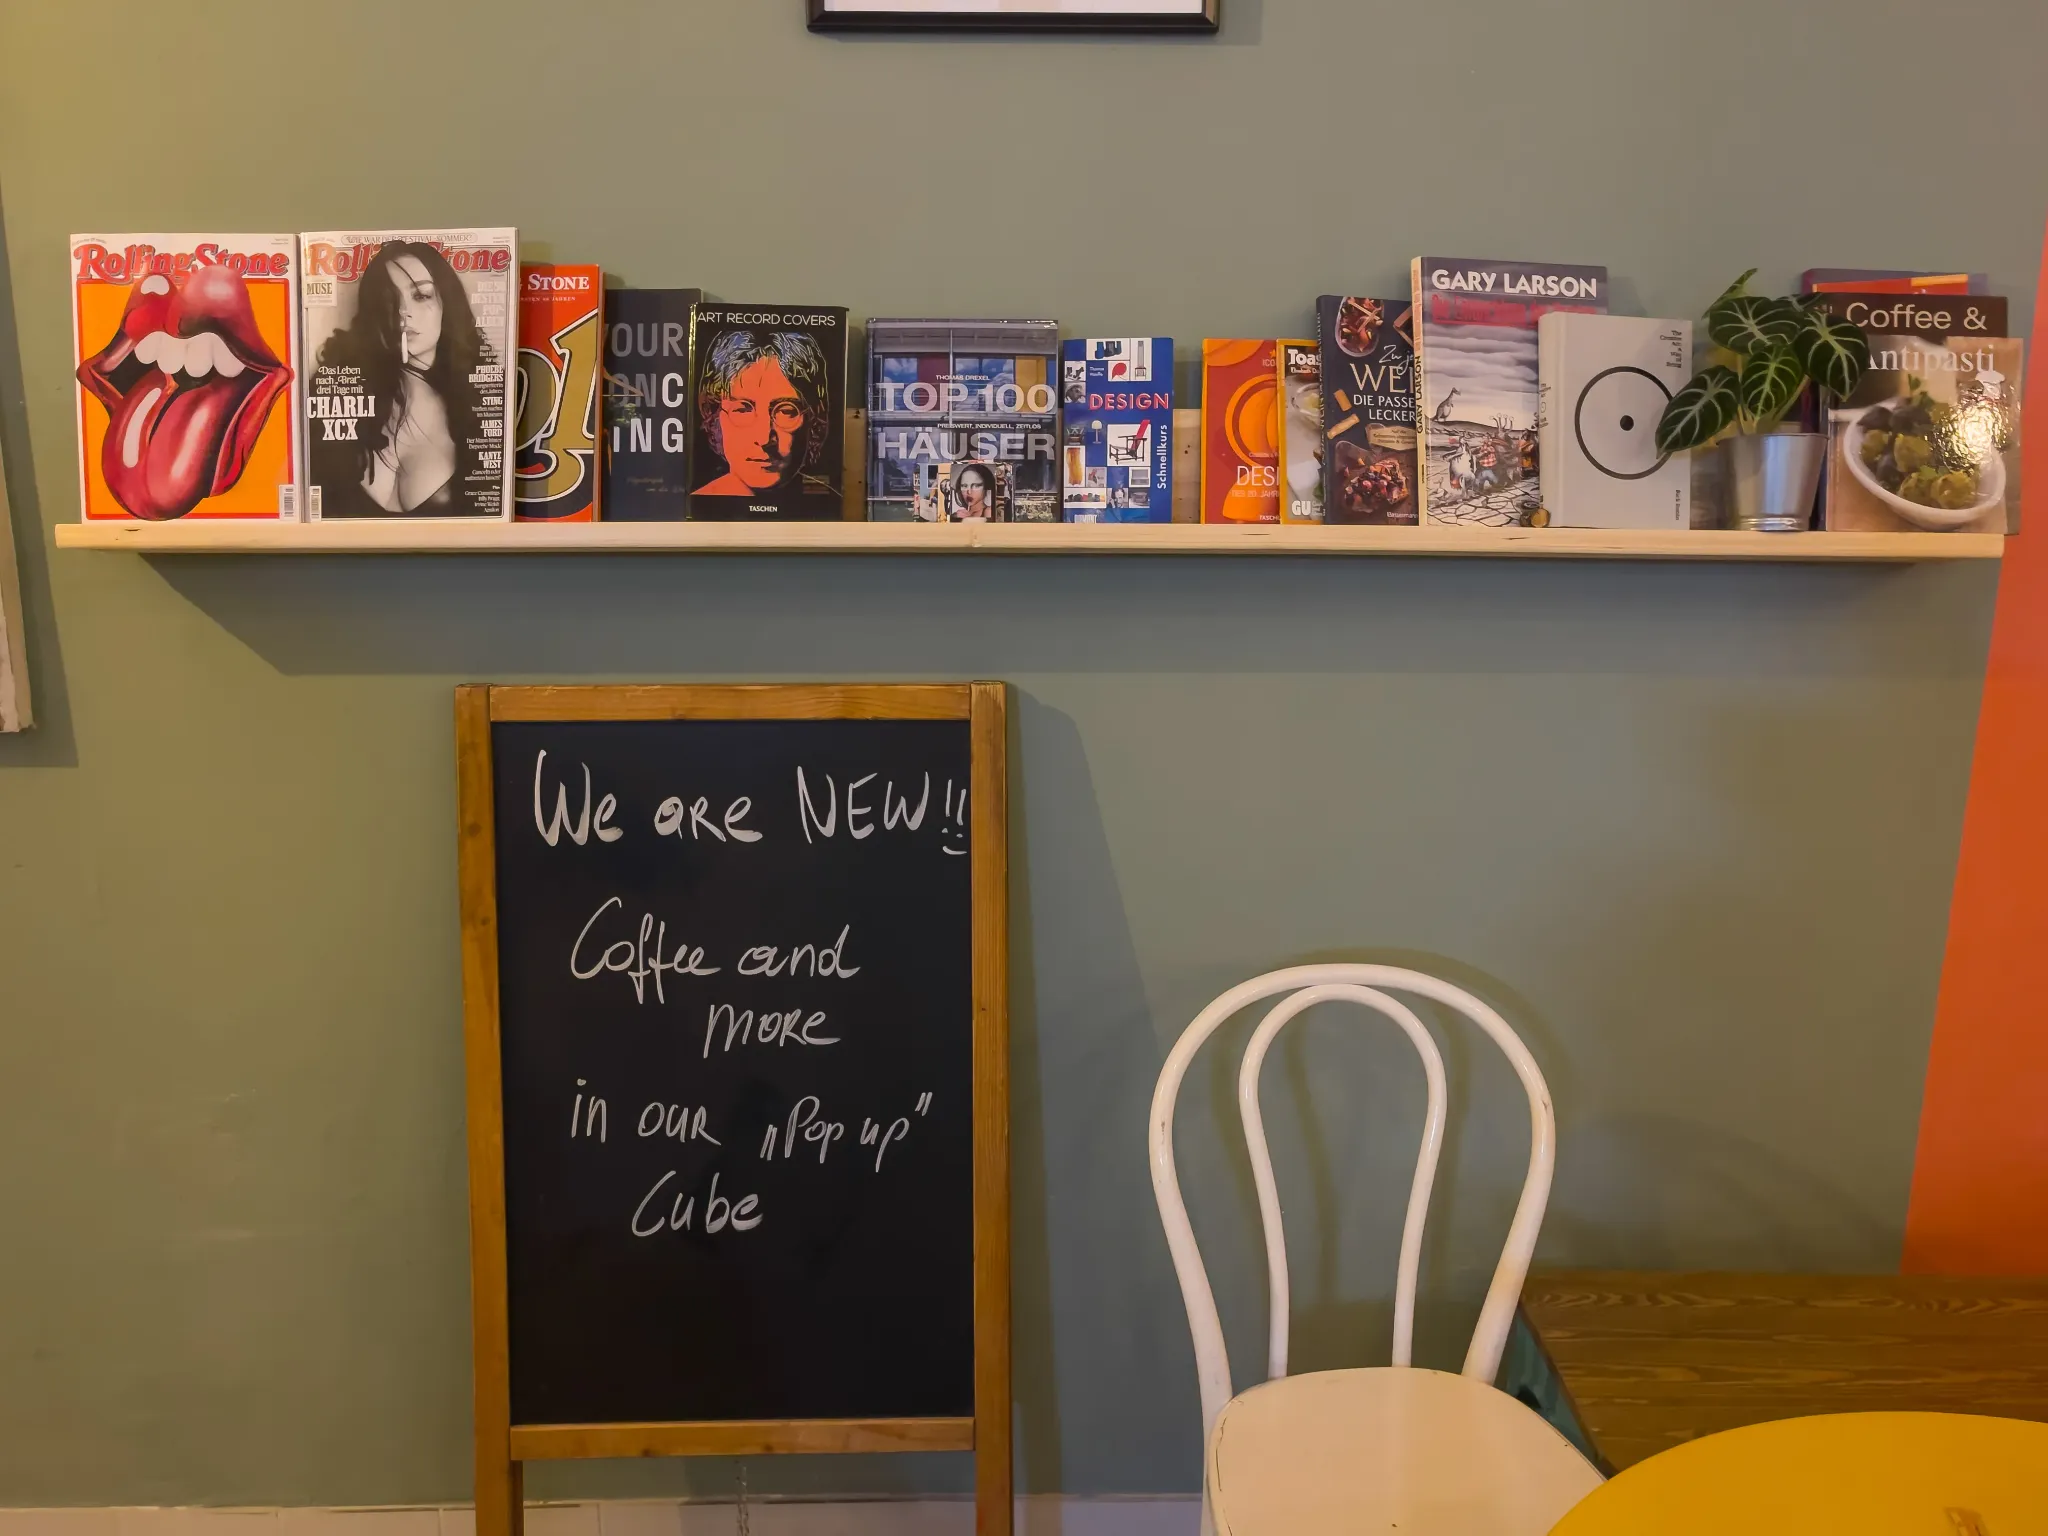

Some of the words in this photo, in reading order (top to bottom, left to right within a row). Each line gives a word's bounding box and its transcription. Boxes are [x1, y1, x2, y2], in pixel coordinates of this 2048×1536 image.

[306, 282, 333, 296] MUSE
[527, 273, 590, 291] STONE
[1431, 269, 1497, 293] GARY
[1503, 272, 1597, 298] LARSON
[697, 312, 723, 323] ART
[726, 313, 780, 325] RECORD
[783, 314, 836, 326] COVERS
[1846, 301, 1951, 330] Coffee
[1963, 306, 1988, 331] &
[318, 366, 336, 375] Das
[337, 365, 361, 375] Leben
[316, 376, 334, 385] nach
[316, 385, 331, 394] drei
[332, 385, 350, 395] Tage
[351, 385, 364, 394] mit
[876, 382, 969, 413] TOP
[978, 383, 1056, 414] 100
[306, 395, 376, 419] CHARLI
[482, 396, 503, 406] STING
[1088, 392, 1169, 411] DESIGN
[1353, 394, 1374, 406] DIE
[322, 418, 358, 441] XCX
[480, 420, 503, 429] JAMES
[483, 429, 503, 438] FORD
[877, 426, 1056, 461] HÄUSER
[478, 451, 502, 461] KANYE
[483, 460, 502, 469] WEST
[1156, 424, 1168, 490] Schnellkurs
[1236, 465, 1280, 487] DESI
[748, 505, 778, 513] TASCHEN
[1291, 499, 1312, 517] GU
[533, 749, 624, 847] We
[570, 896, 722, 1005] Coffee
[737, 923, 861, 979] and
[570, 1078, 607, 1143] in
[631, 1170, 764, 1238] Cube
